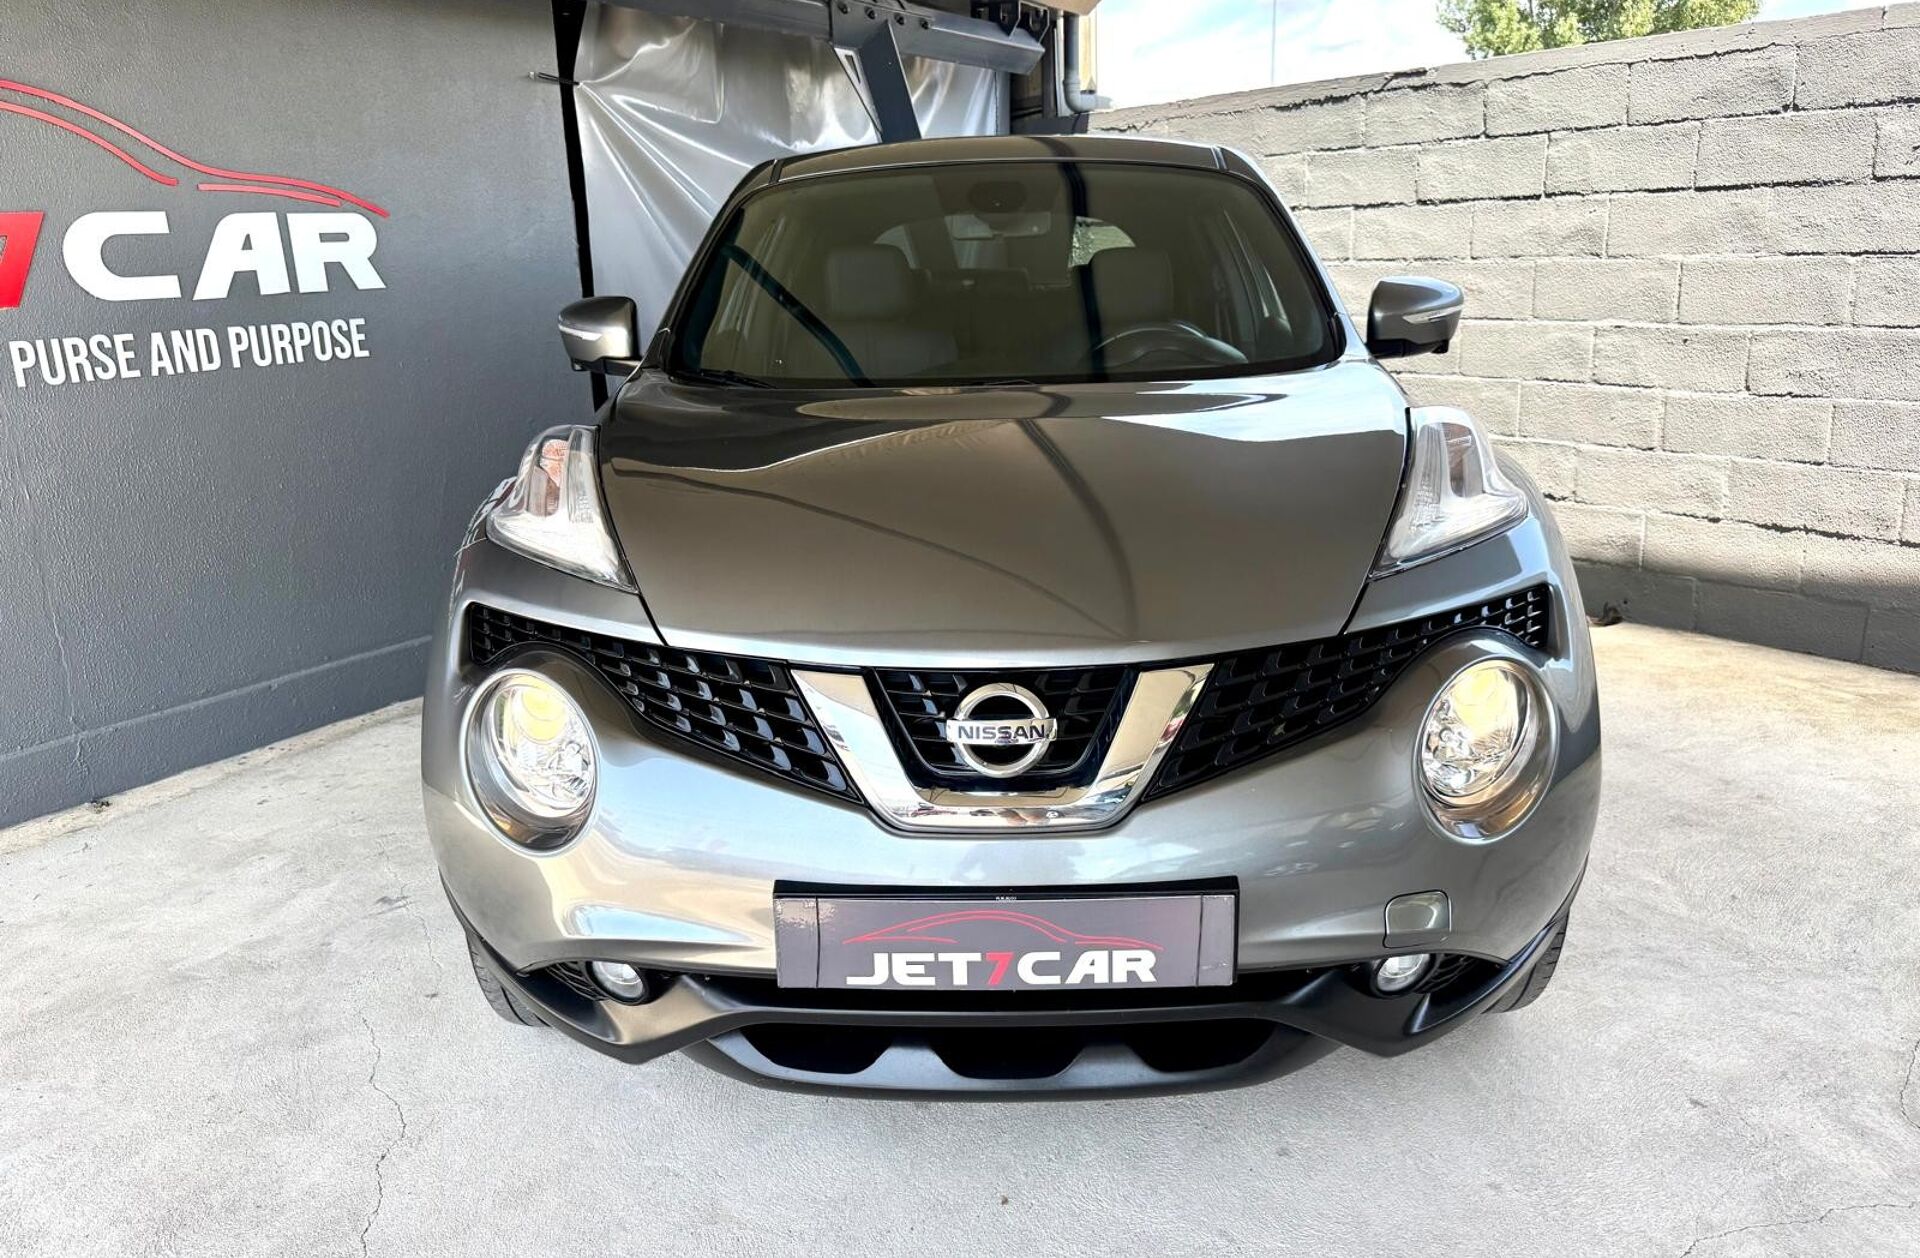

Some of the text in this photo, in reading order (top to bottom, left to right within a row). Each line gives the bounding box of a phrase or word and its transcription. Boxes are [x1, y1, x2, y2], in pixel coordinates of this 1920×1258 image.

[9, 318, 370, 388] PURSE AND PURPOSE
[958, 724, 1045, 740] NISSAN
[846, 949, 1157, 985] JET7CAR
